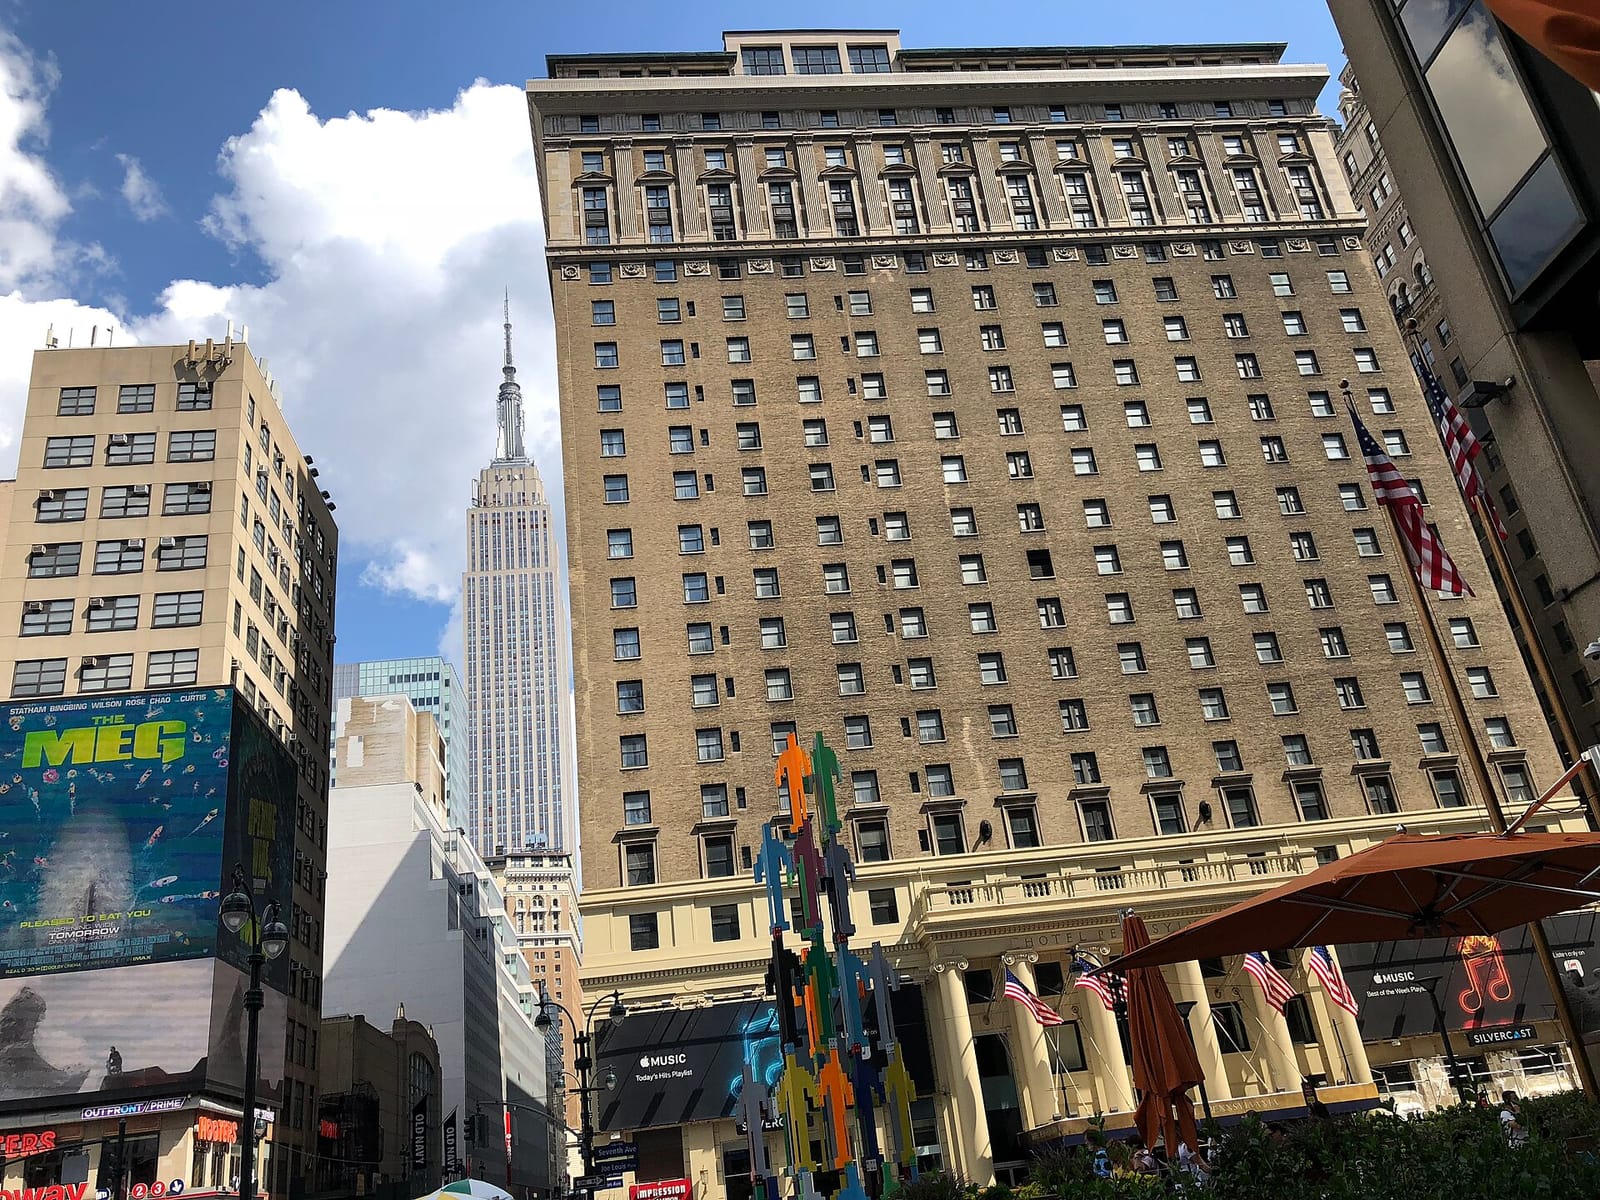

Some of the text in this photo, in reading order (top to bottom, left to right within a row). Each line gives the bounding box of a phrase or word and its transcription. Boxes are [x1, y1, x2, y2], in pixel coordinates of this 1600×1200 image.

[10, 706, 46, 715] STATHAM
[49, 703, 87, 712] BINGBING
[91, 700, 122, 709] WILSON
[125, 698, 146, 706] ROSE
[180, 694, 206, 702] CURTIS
[91, 714, 125, 725] THE
[22, 720, 186, 768] MEG
[20, 918, 75, 928] PLEASED
[100, 912, 122, 920] EAT
[49, 927, 120, 939] TOMORROW
[1025, 932, 1086, 948] HOTEL
[1382, 971, 1415, 983] MUSIC
[650, 1053, 687, 1067] MUSIC
[635, 1069, 693, 1081] Today's Hits Playlist
[84, 1099, 181, 1118] OUTFRONT PRIME
[198, 1116, 238, 1144] HOOTERS
[415, 1113, 425, 1164] OLD NAVY
[446, 1126, 456, 1172] OLD NAVY
[598, 1147, 624, 1157] Seventh
[601, 1165, 611, 1173] Joe
